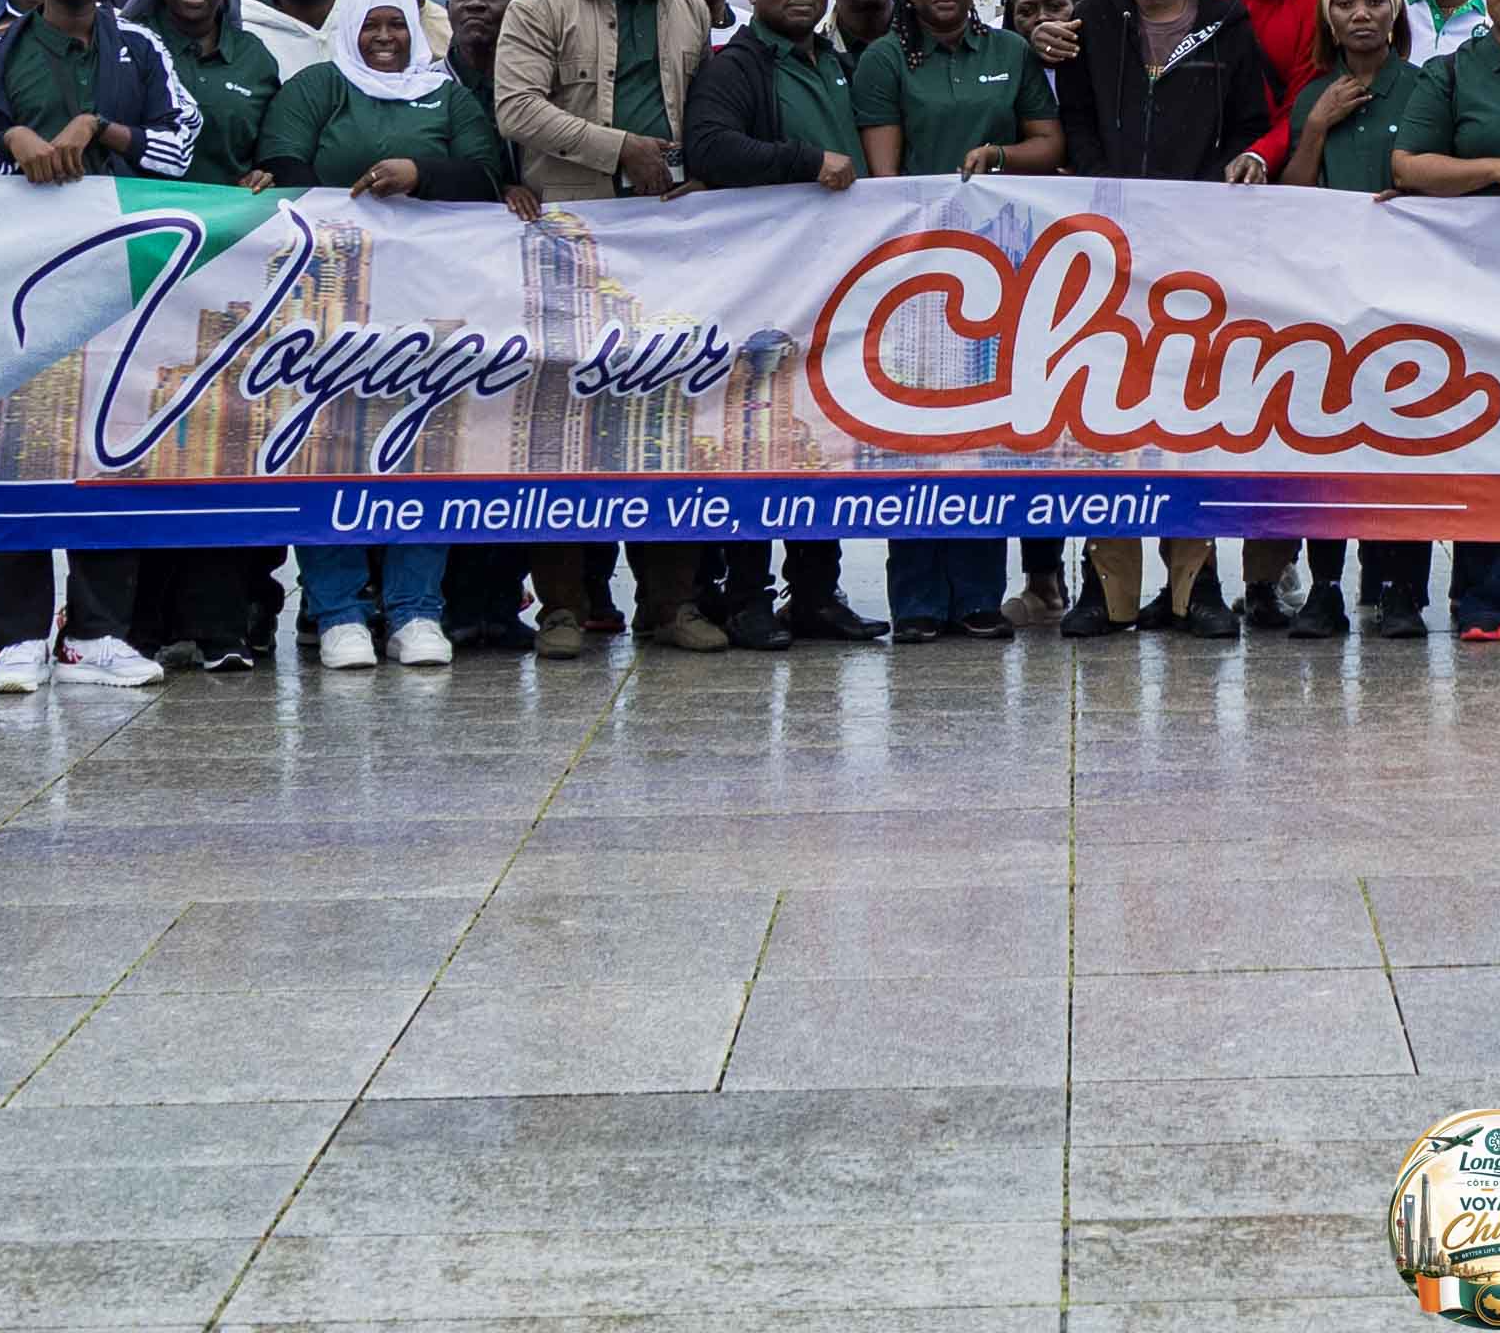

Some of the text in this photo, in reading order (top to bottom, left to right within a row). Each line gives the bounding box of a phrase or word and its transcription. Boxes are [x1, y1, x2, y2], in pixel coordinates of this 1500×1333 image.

[11, 200, 730, 473] Voyage sur
[329, 484, 1169, 535] Une meilleure vie, un meilleur avenir
